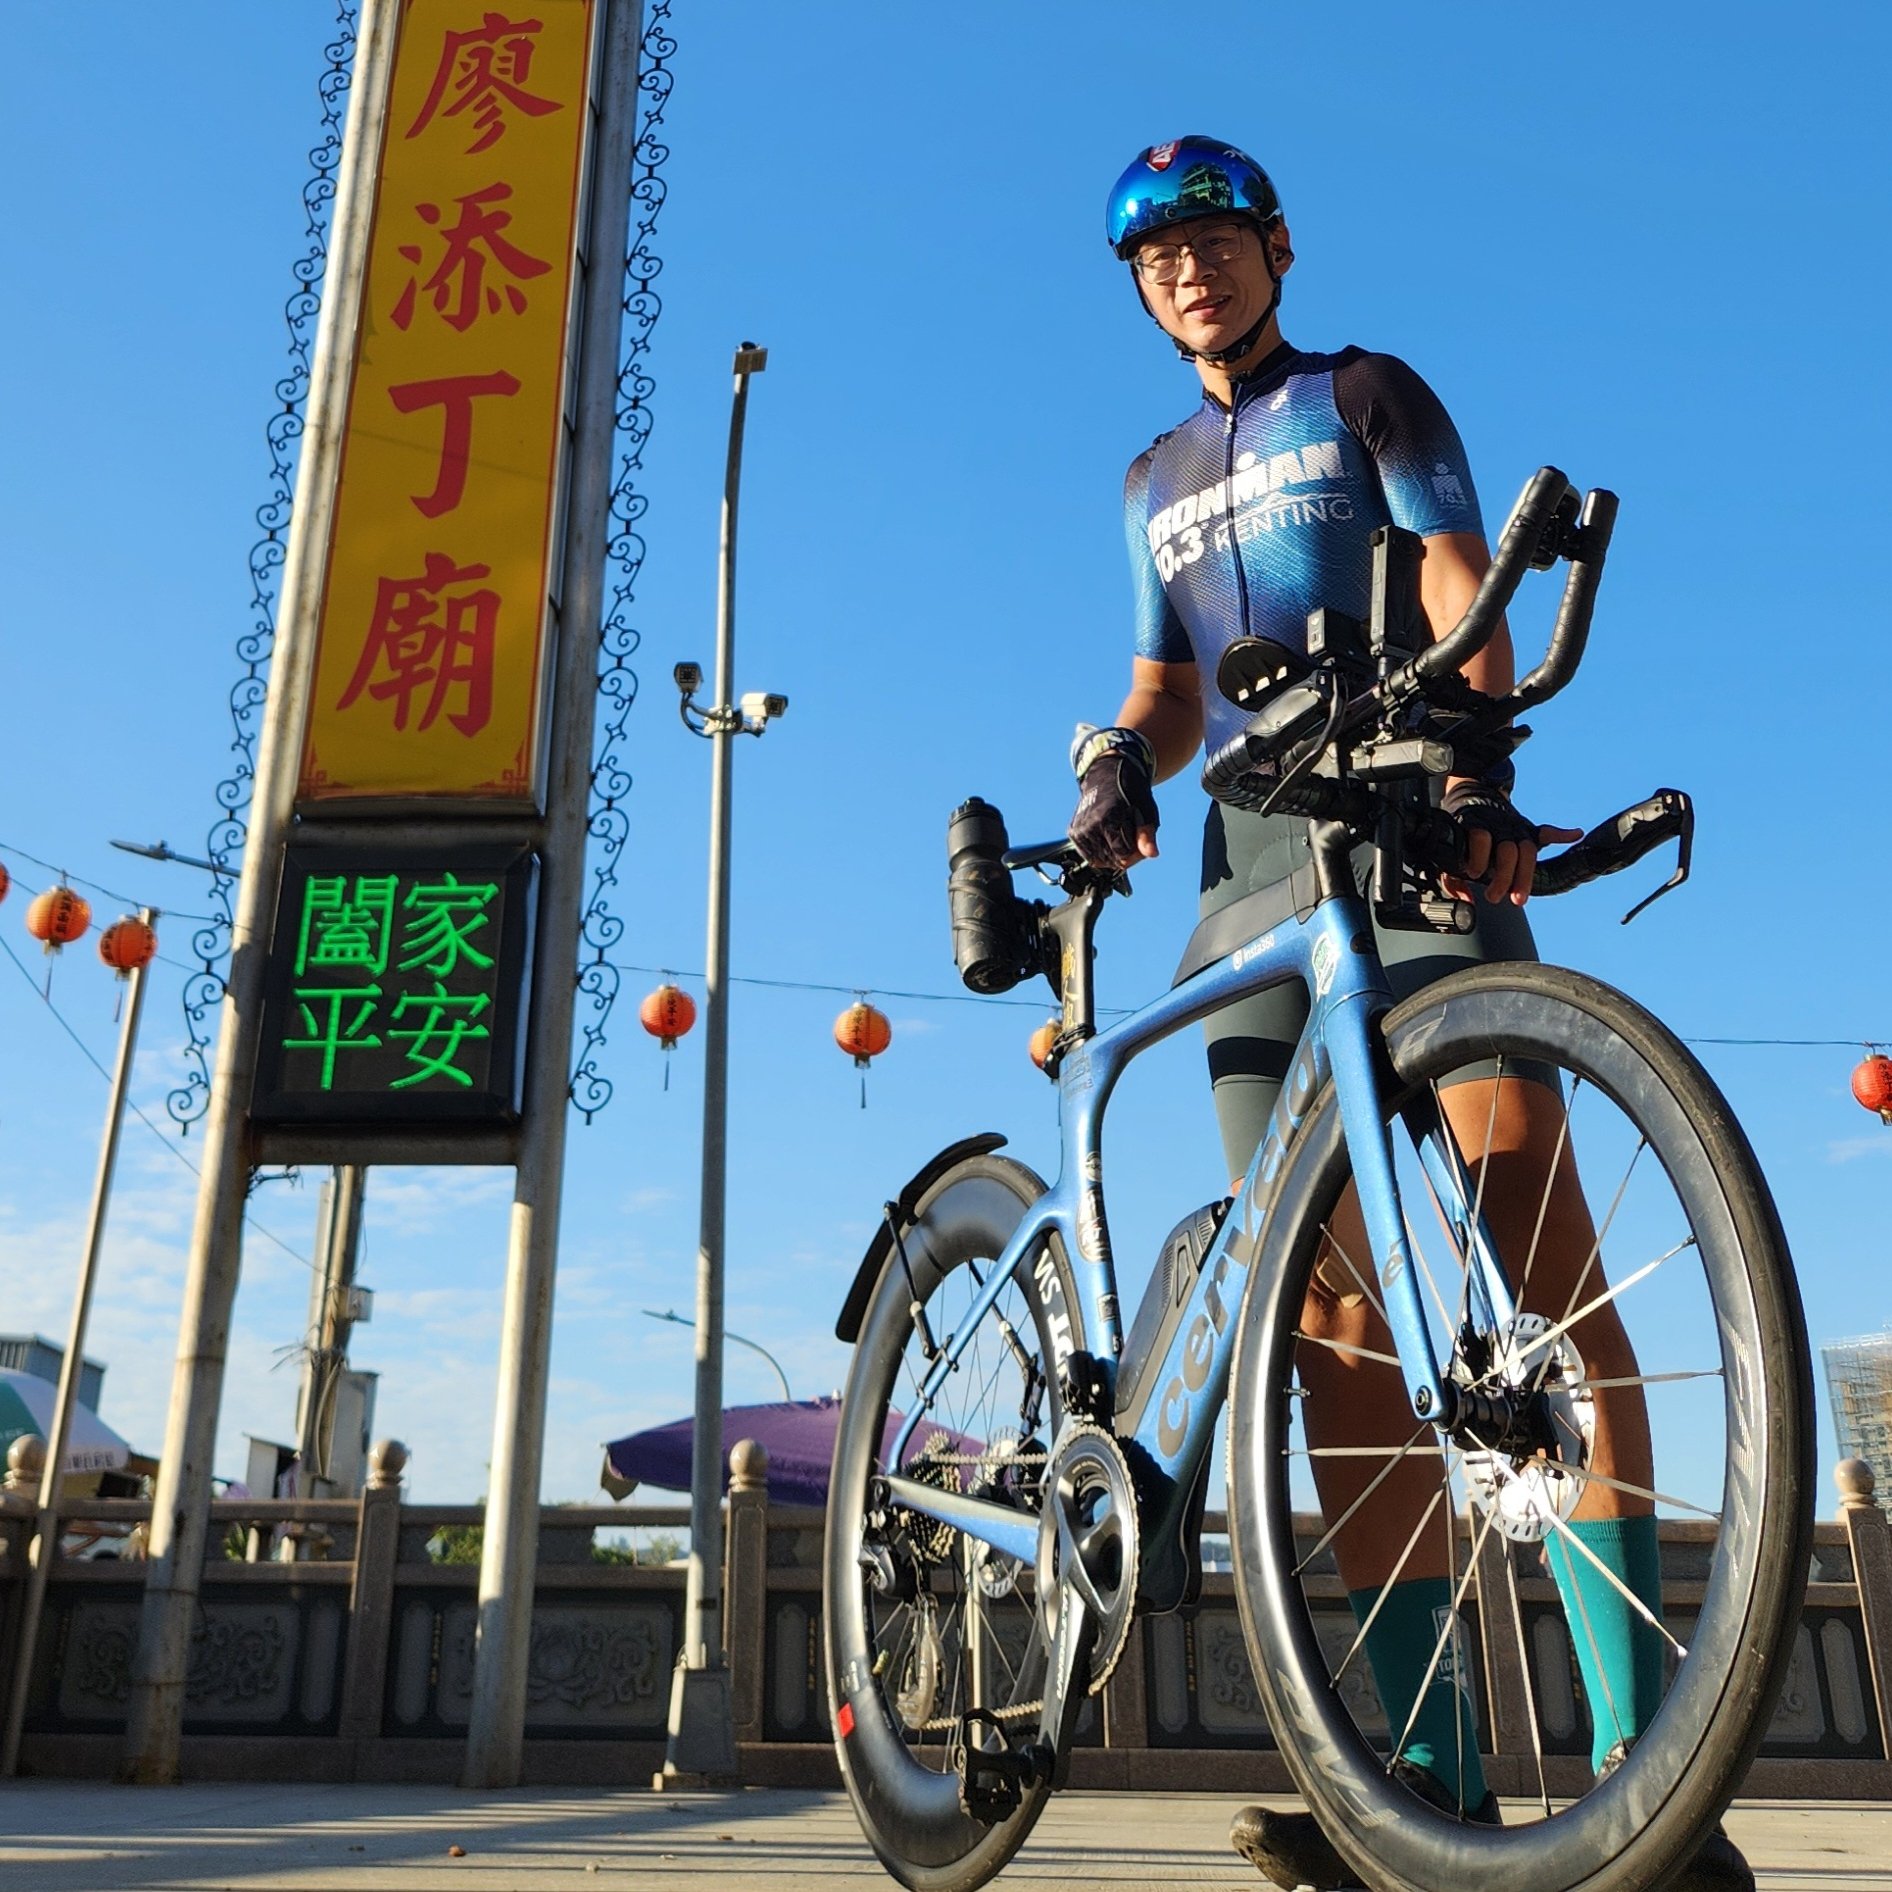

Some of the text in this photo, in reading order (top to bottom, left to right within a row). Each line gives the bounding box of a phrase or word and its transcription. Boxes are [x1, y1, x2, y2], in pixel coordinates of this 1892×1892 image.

[337, 12, 565, 740] 廖添丁廟
[1147, 441, 1345, 557] IRONMAN
[1214, 499, 1355, 553] KENTING
[294, 871, 500, 978] 闔家
[282, 981, 492, 1090] 平安
